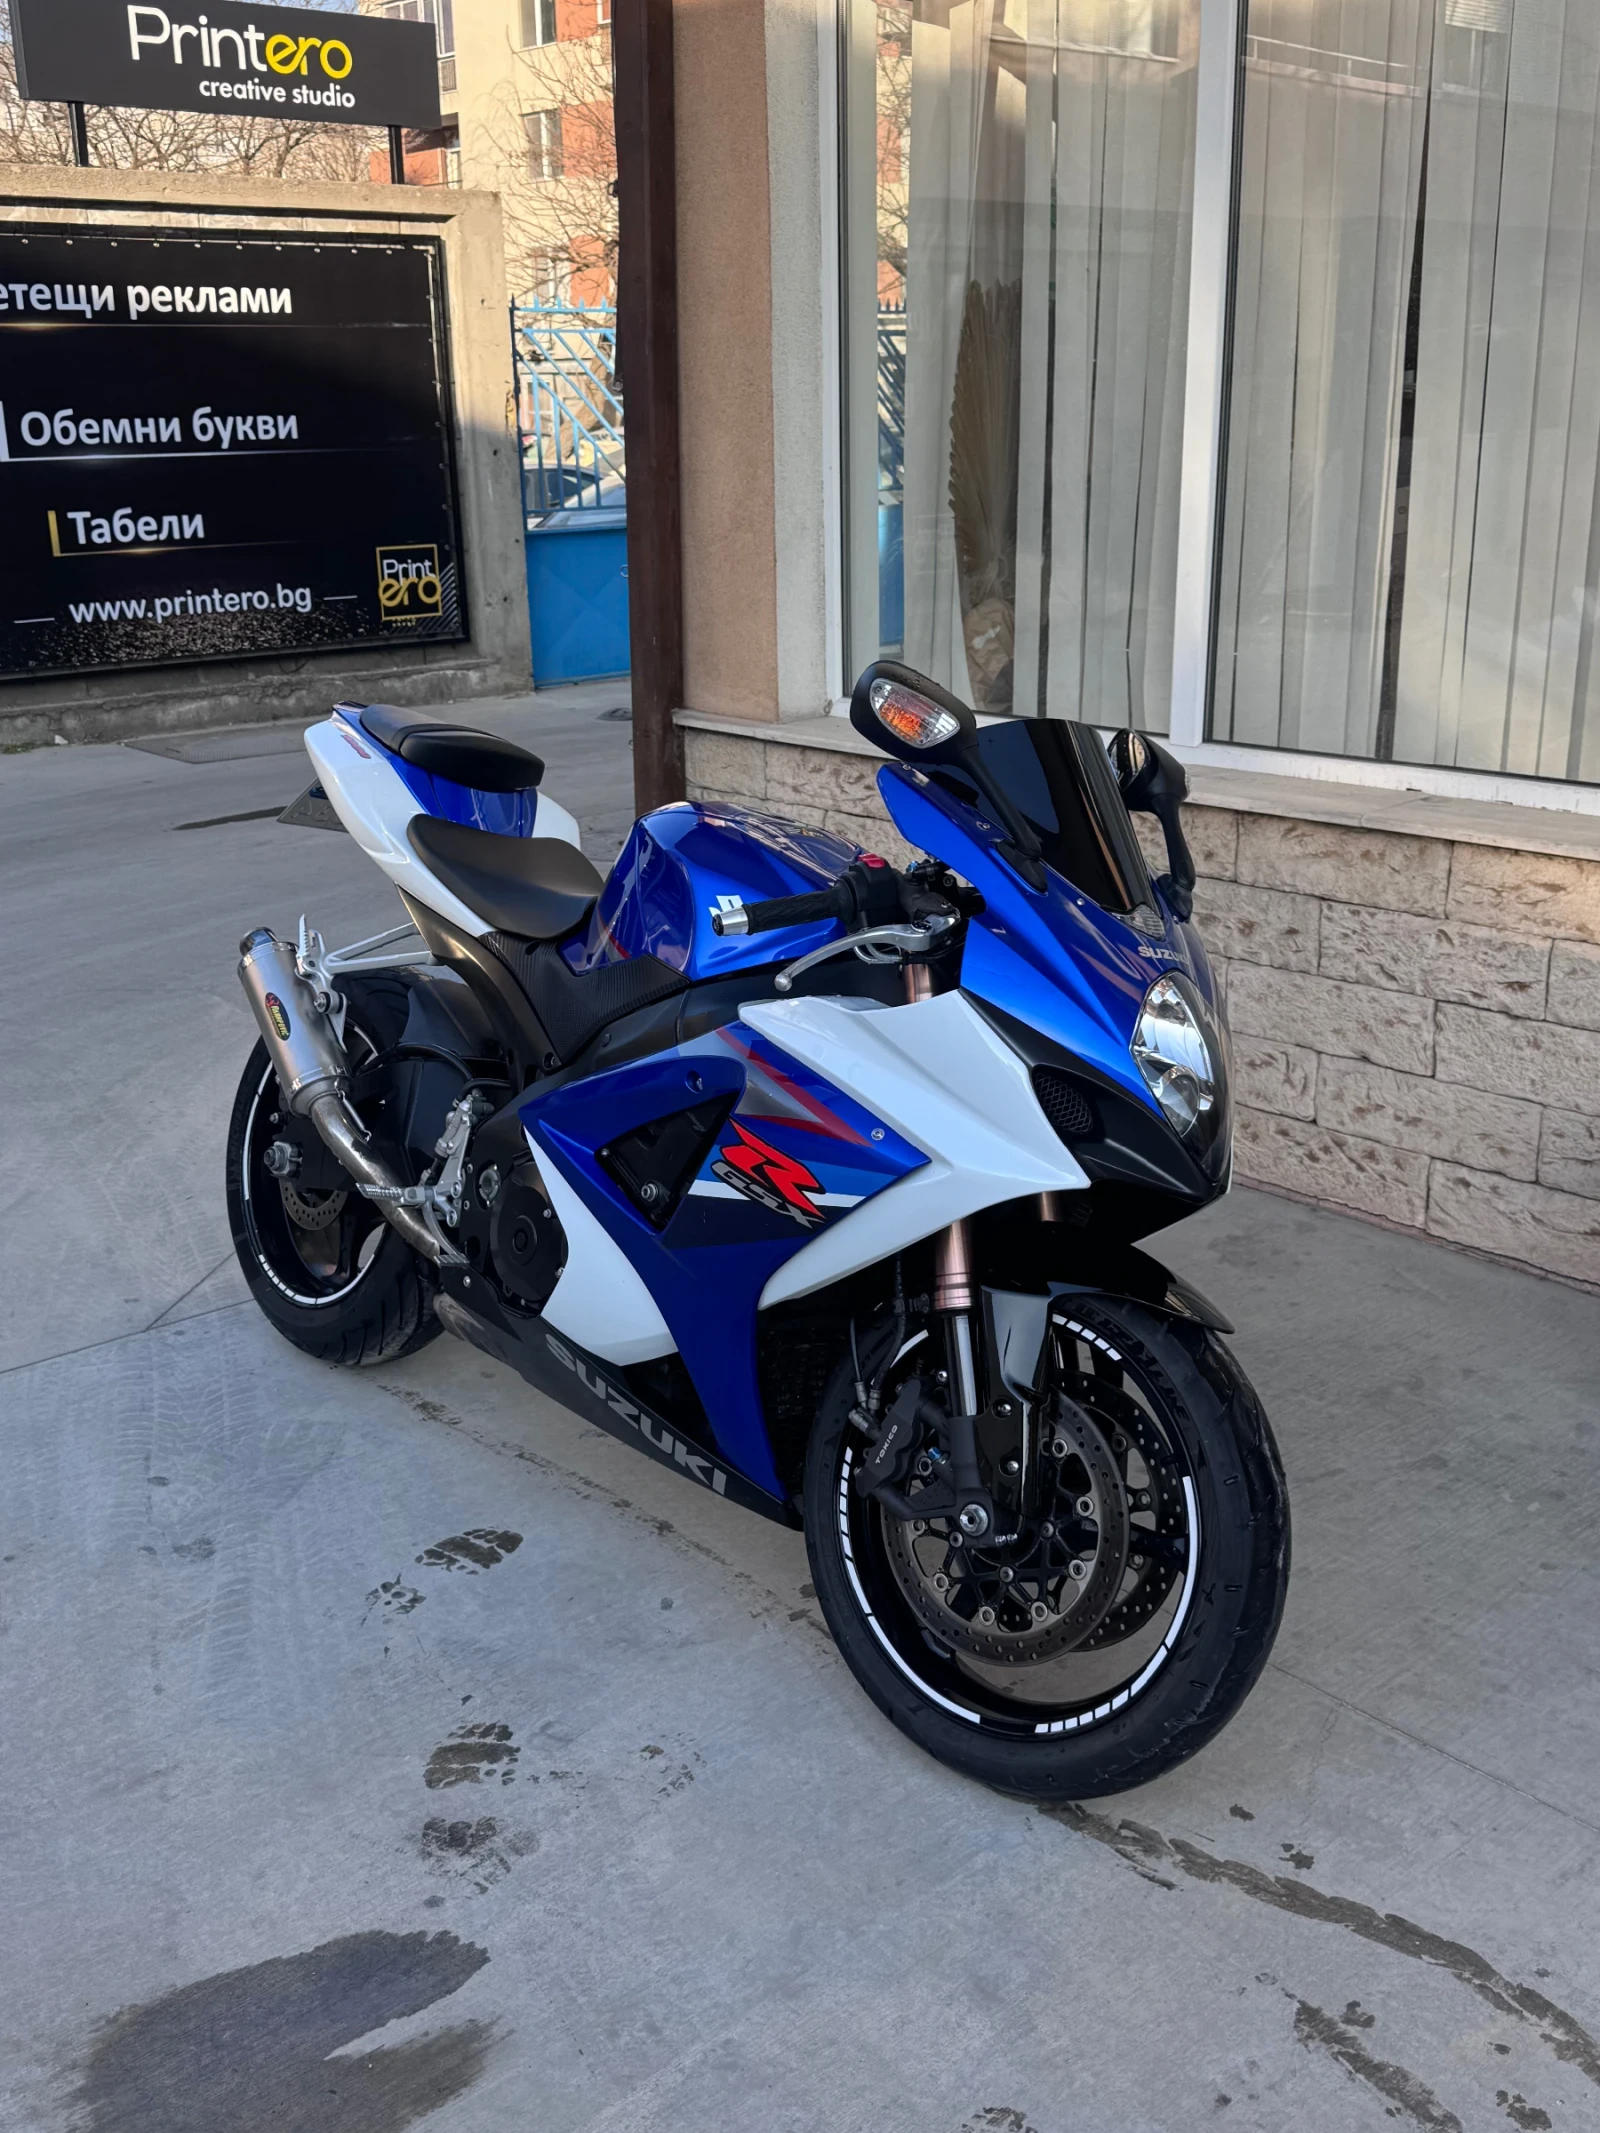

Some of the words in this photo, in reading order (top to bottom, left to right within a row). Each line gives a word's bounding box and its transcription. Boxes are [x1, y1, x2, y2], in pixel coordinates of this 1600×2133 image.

[127, 4, 353, 79] Printero
[199, 77, 286, 103] creative
[292, 82, 356, 108] studio
[127, 285, 293, 320] реклами
[20, 408, 182, 447] Обемни
[192, 406, 299, 449] букви
[67, 507, 205, 545] Табели
[378, 575, 442, 607] ero
[382, 559, 436, 587] Print
[69, 583, 312, 623] www.printero.bg
[545, 1333, 727, 1496] SUZUKI
[875, 1425, 898, 1464] TOKICO
